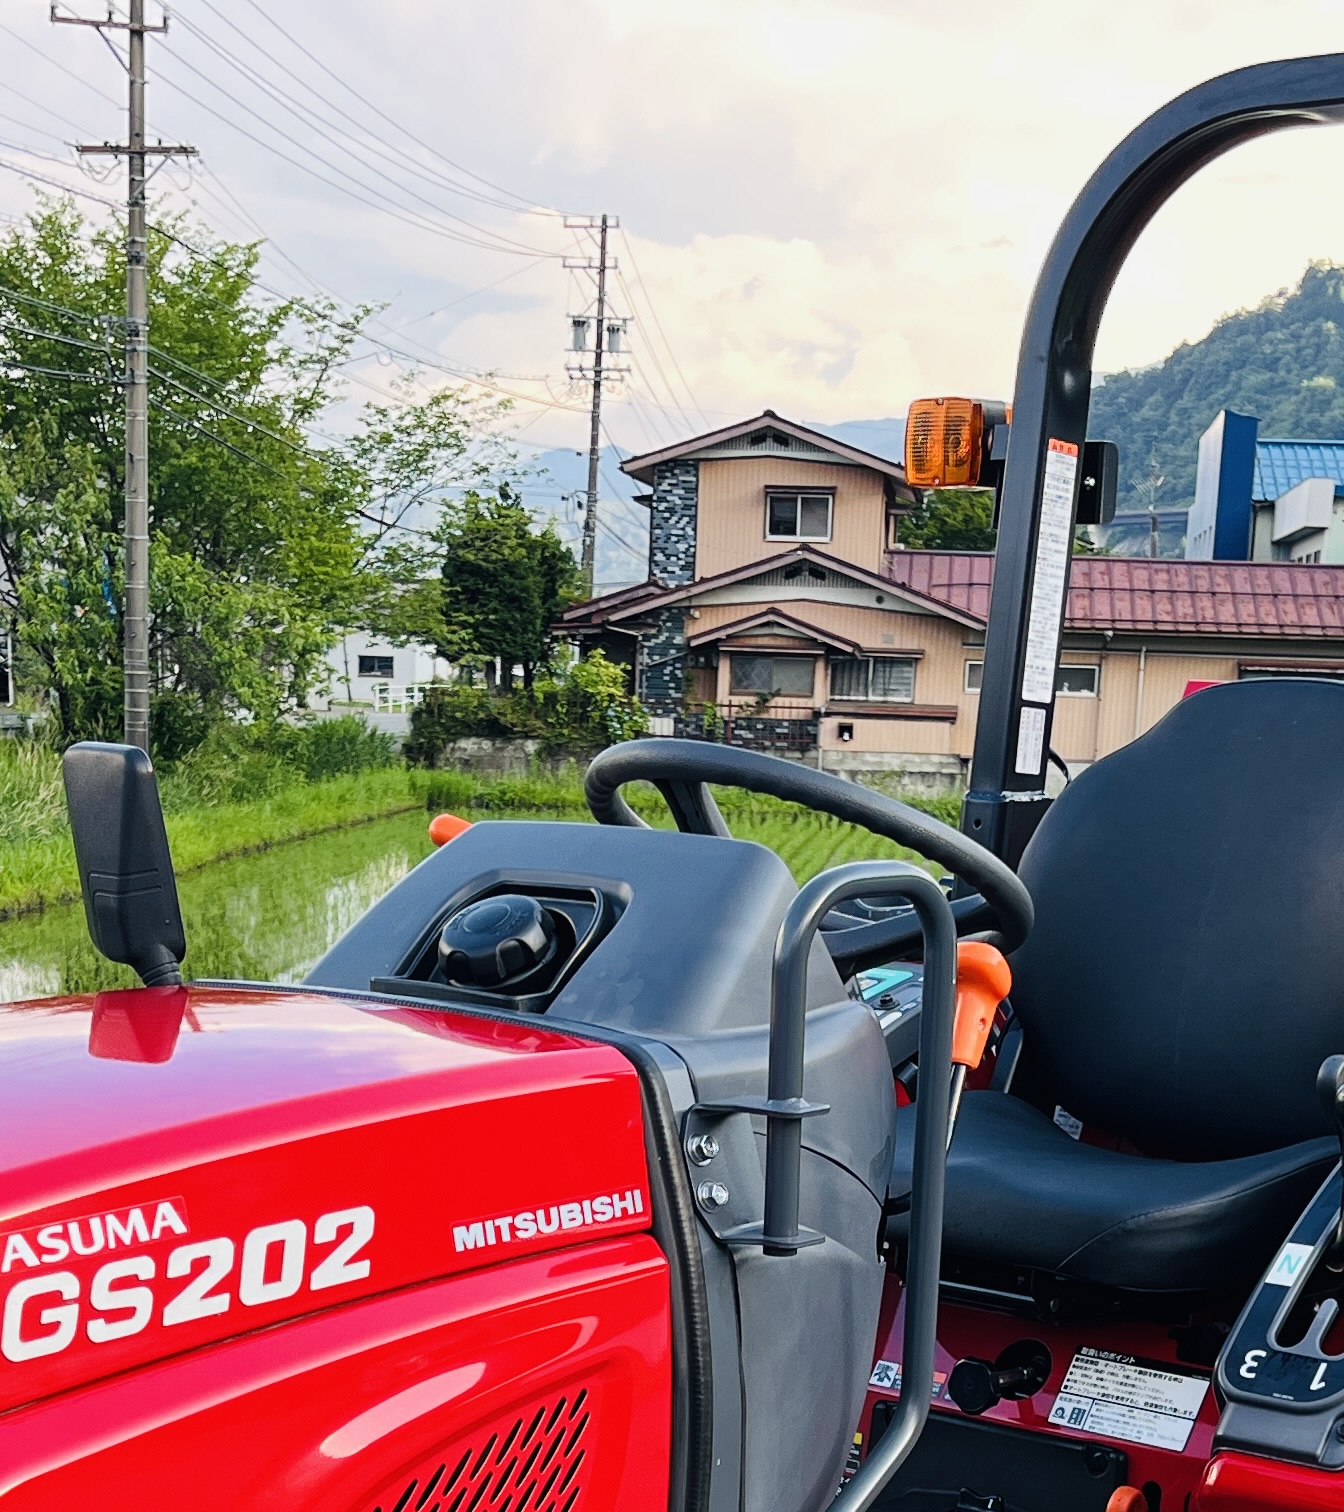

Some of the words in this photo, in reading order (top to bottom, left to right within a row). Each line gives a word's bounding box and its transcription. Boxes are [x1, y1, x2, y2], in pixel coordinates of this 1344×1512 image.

[0, 1202, 189, 1274] ASUMA
[452, 1189, 644, 1253] MITSUBISHI
[0, 1205, 376, 1363] GS202
[1276, 1252, 1304, 1277] N
[1239, 1348, 1268, 1380] 3
[1308, 1361, 1329, 1392] 1
